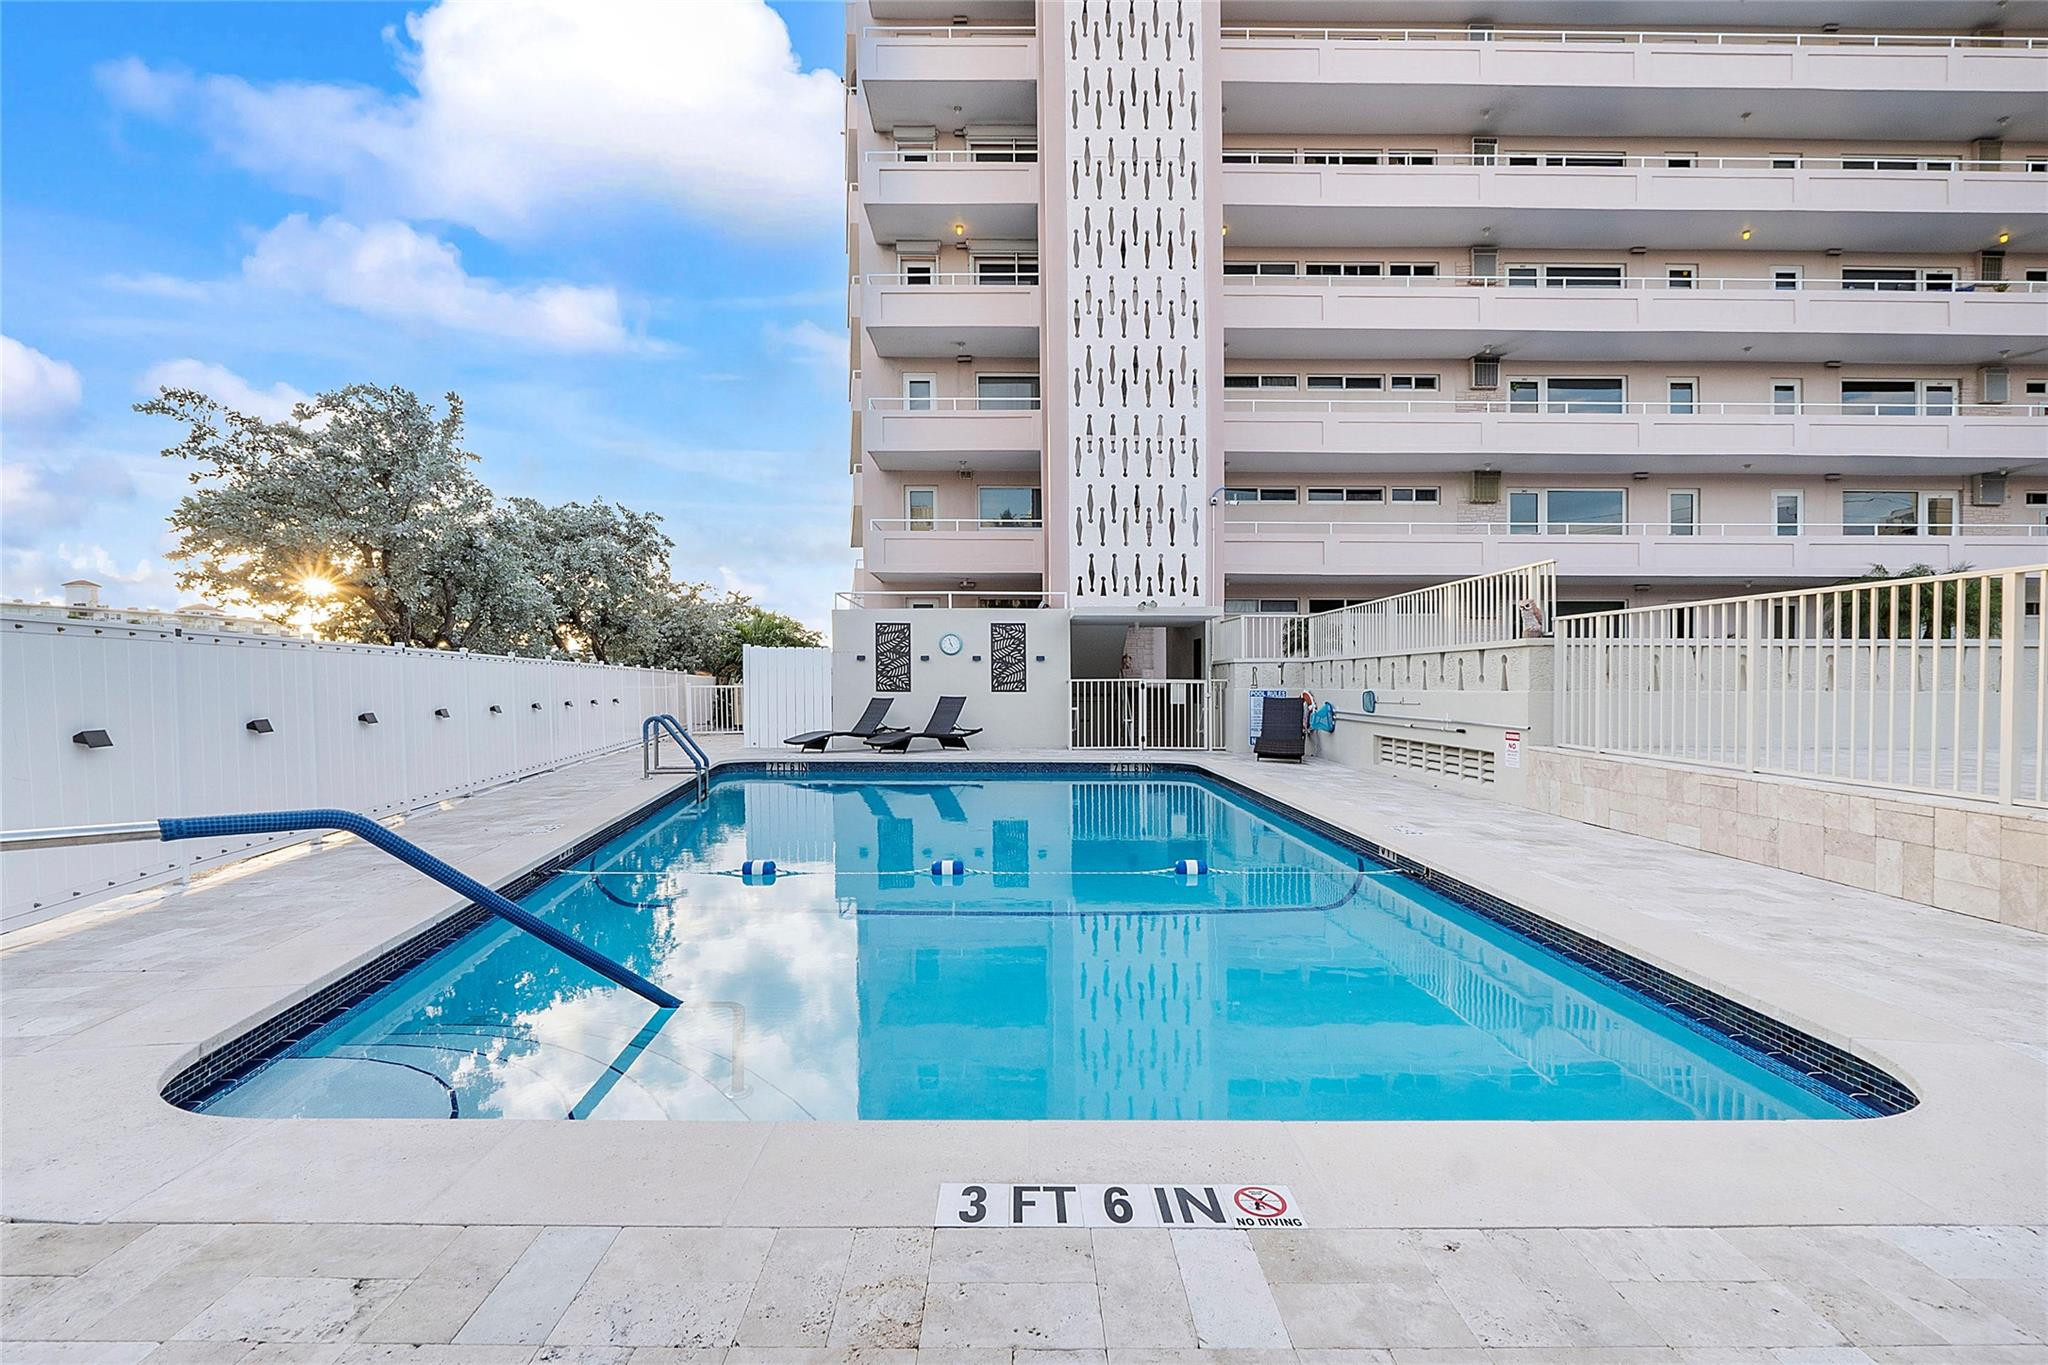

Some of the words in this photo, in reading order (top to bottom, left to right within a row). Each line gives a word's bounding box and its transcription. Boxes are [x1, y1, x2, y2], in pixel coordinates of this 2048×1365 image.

[1250, 690, 1265, 698] POOL
[1266, 690, 1287, 698] RULES
[777, 762, 787, 771] FT
[798, 762, 808, 771] IN
[1121, 763, 1131, 772] FT
[1142, 763, 1152, 772] IN
[958, 1185, 988, 1224] 3
[1012, 1186, 1076, 1224] FT
[1104, 1186, 1134, 1224] 6
[1154, 1187, 1227, 1224] IN
[1236, 1217, 1255, 1226] NO
[1257, 1218, 1303, 1227] DIVING
